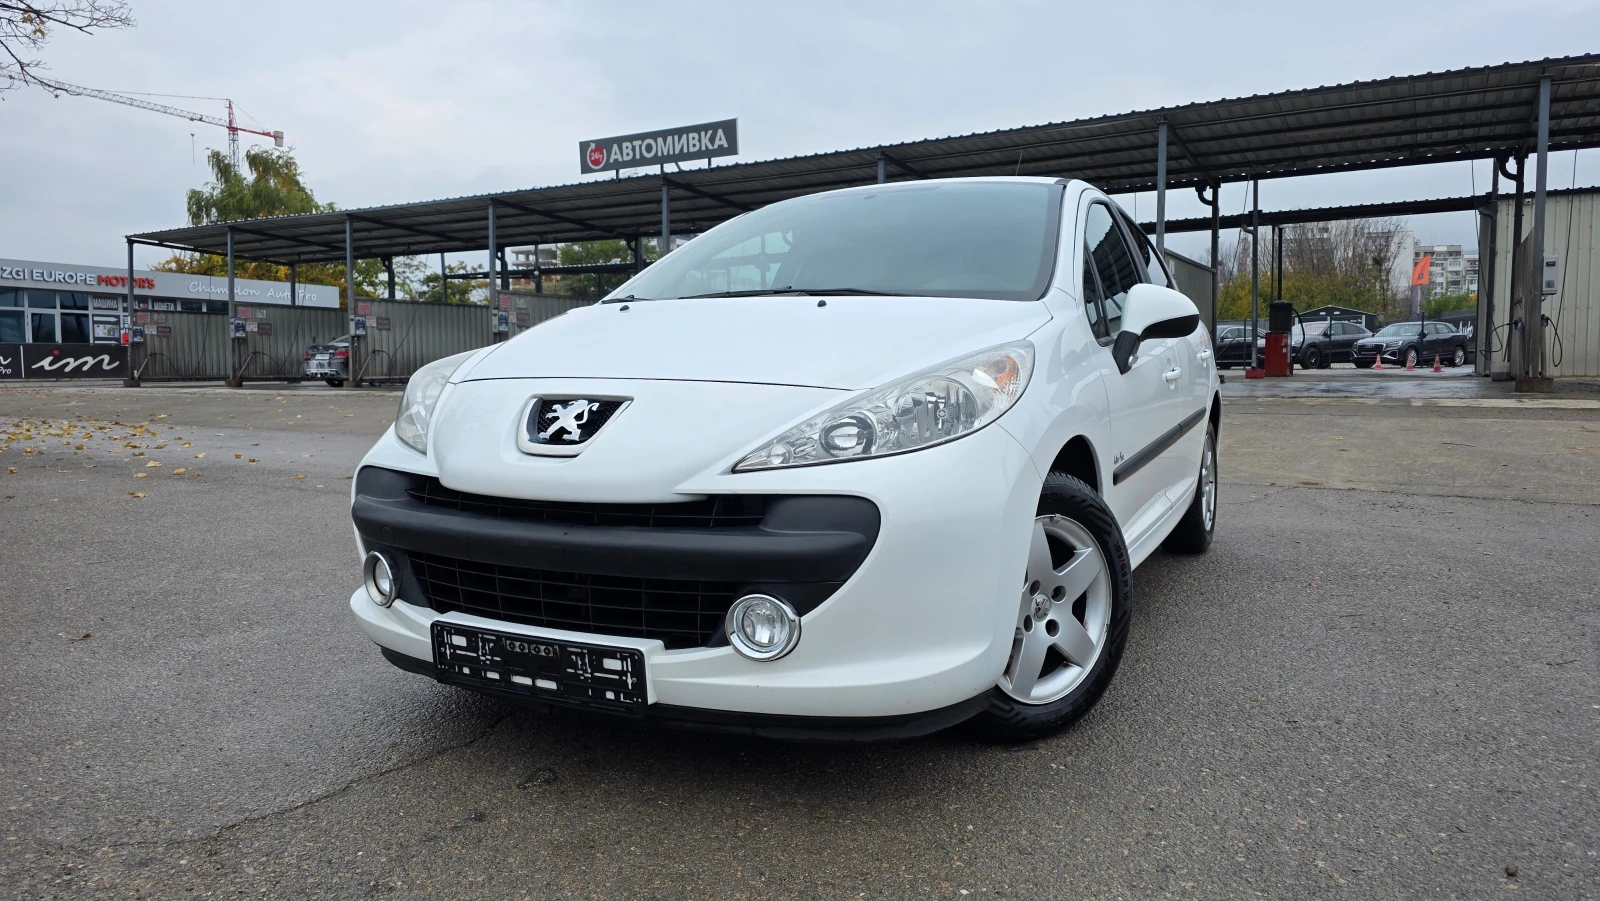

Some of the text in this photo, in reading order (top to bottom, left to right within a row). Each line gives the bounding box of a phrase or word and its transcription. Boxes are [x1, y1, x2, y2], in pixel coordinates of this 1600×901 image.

[609, 128, 729, 163] АВТОМИВКА
[0, 266, 28, 280] ZGI
[32, 268, 96, 285] EUROPE
[188, 281, 260, 296] Chamion
[298, 289, 317, 301] Pro
